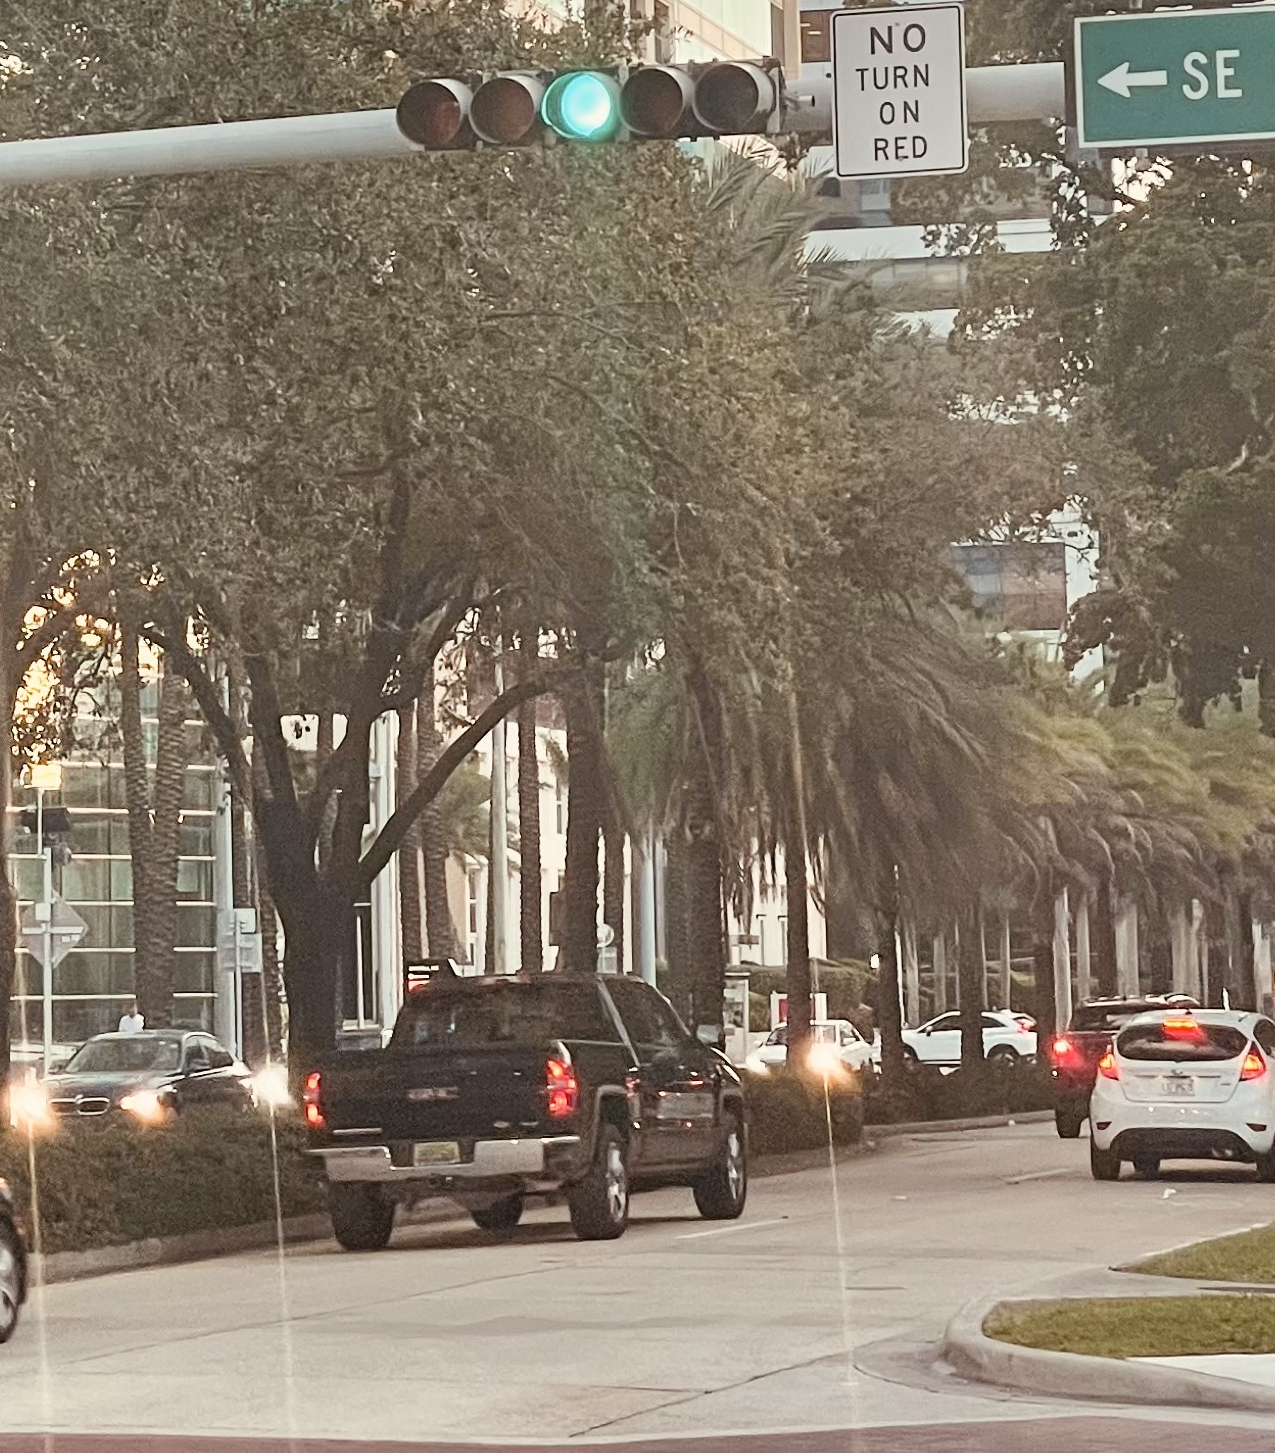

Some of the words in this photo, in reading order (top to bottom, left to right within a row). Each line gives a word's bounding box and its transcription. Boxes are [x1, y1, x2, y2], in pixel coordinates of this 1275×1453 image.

[869, 23, 926, 55] NO
[855, 63, 930, 92] TURN
[1181, 49, 1243, 101] SE
[879, 99, 920, 125] ON
[873, 135, 928, 162] RED
